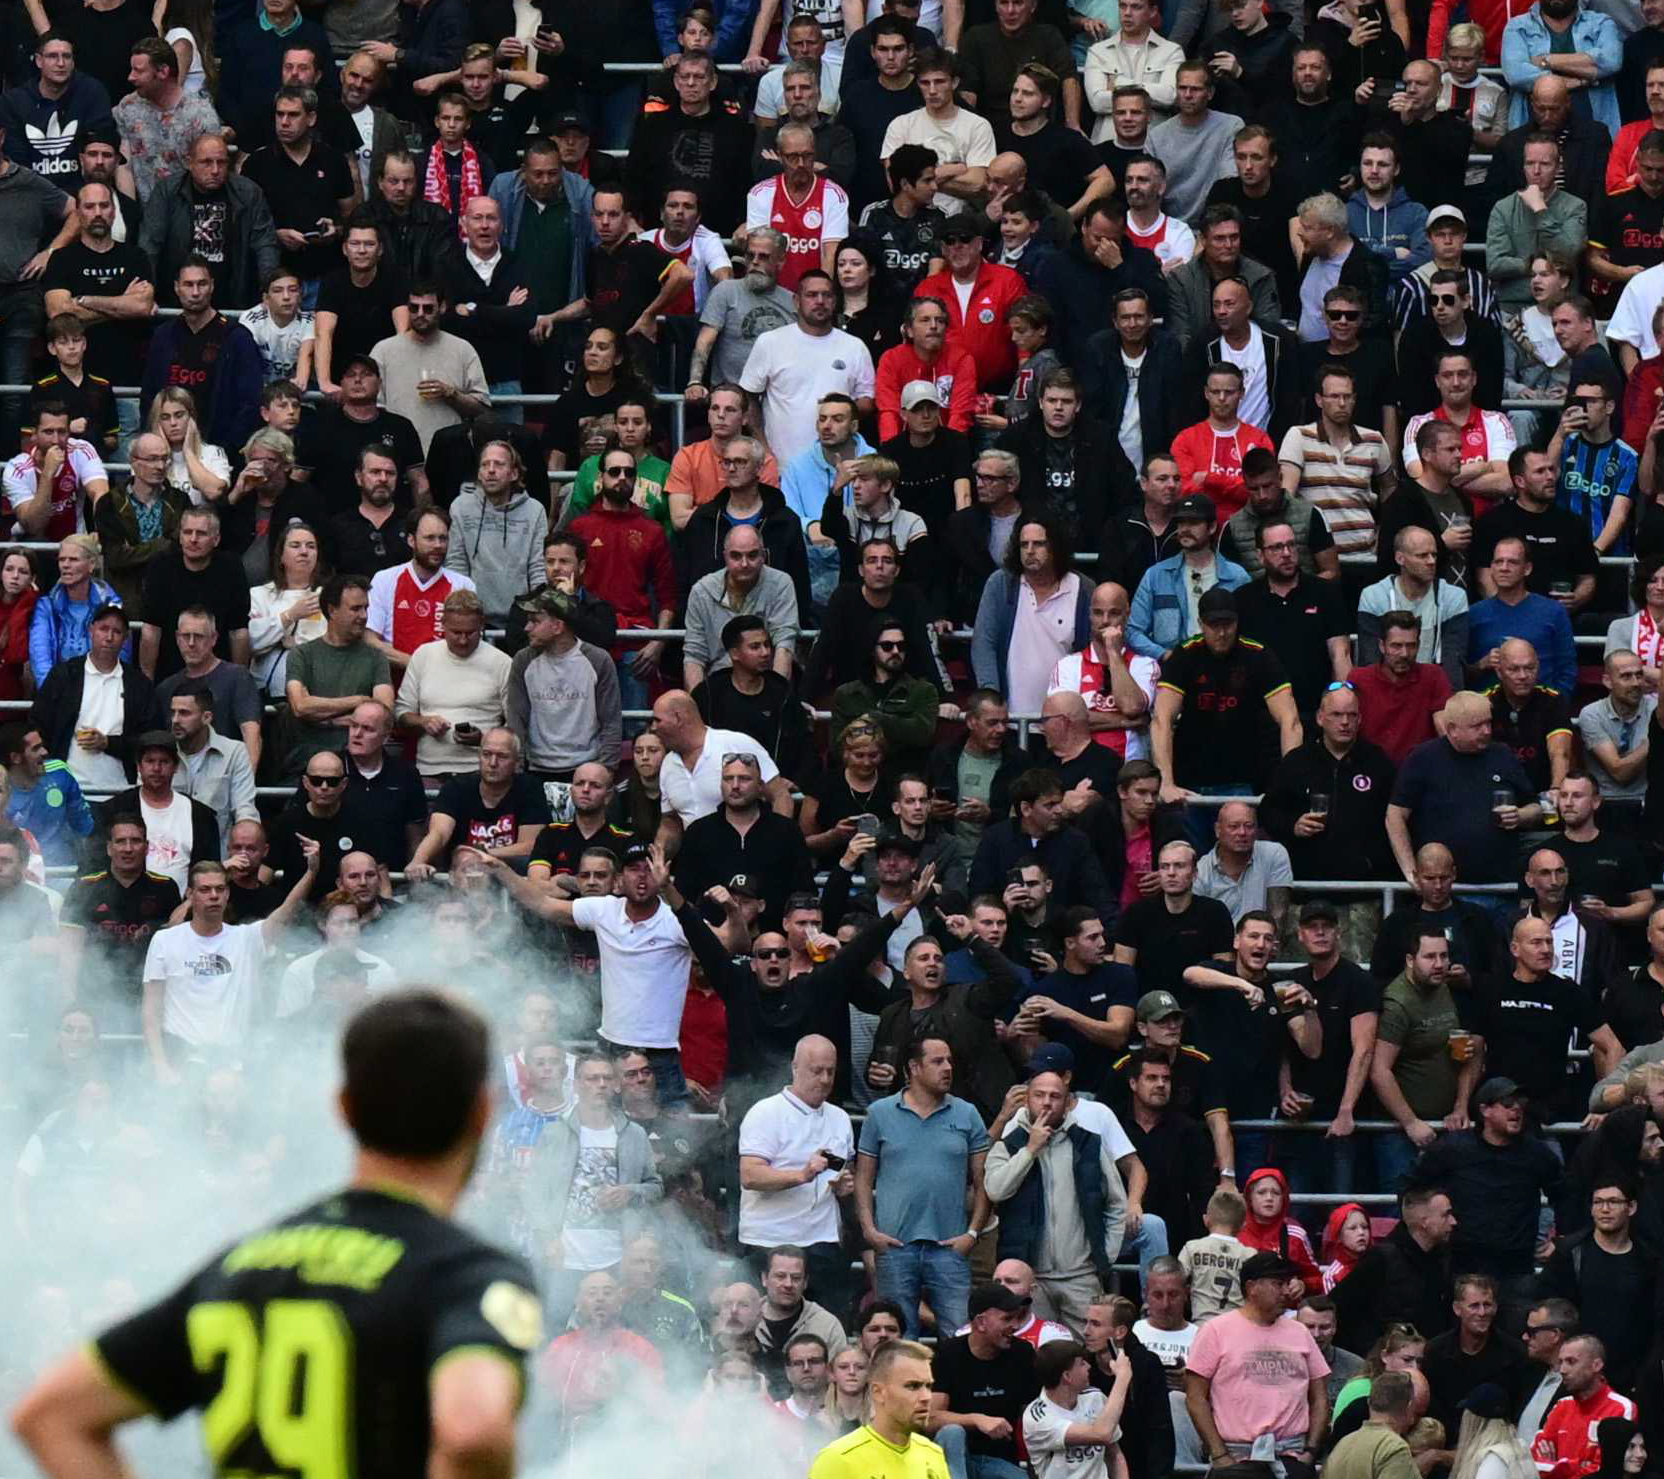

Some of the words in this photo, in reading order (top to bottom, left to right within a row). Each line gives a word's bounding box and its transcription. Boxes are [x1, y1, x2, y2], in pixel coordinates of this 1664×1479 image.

[32, 158, 78, 176] adidas
[782, 232, 819, 251] iggo
[884, 248, 928, 268] Ziggo
[1564, 471, 1611, 495] Ziggo
[1192, 1252, 1241, 1270] BERGWI
[1216, 1277, 1233, 1310] 7
